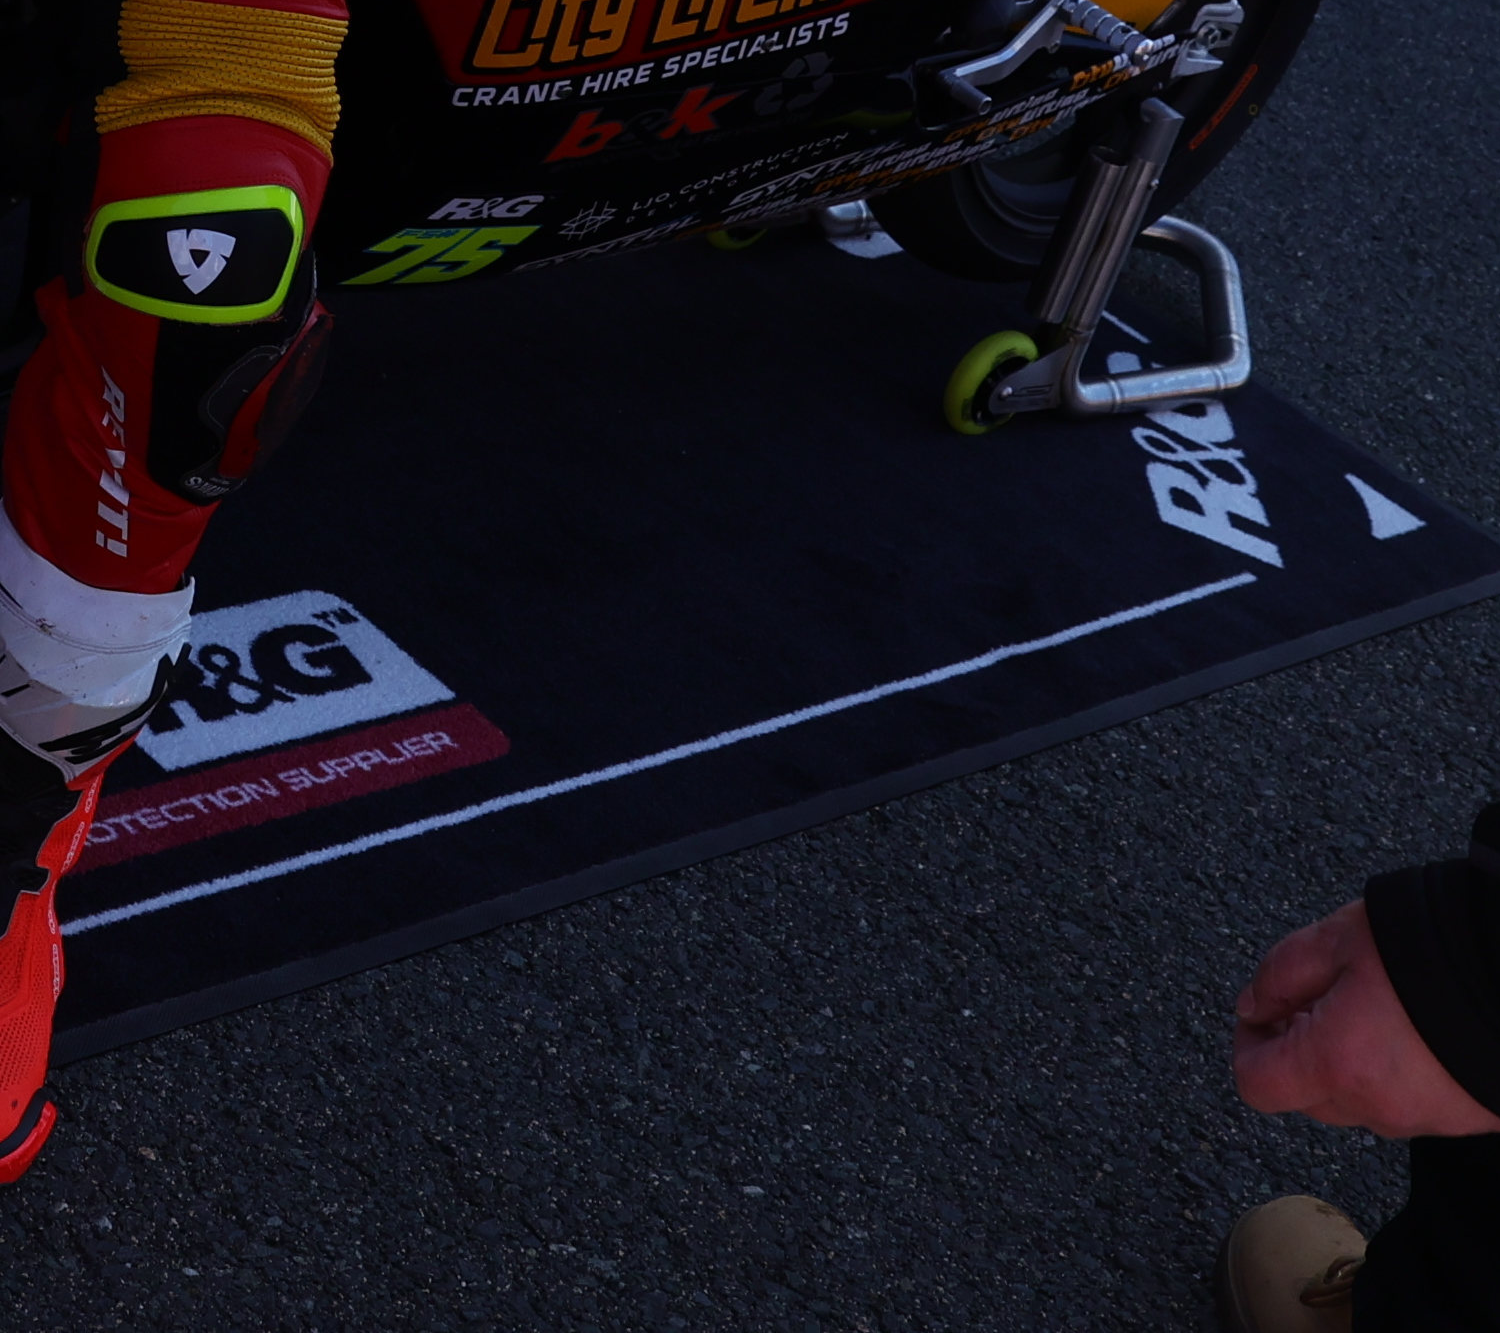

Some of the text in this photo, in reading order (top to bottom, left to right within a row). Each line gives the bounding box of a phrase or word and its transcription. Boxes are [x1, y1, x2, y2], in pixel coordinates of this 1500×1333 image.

[451, 11, 853, 107] CRANE HIRE SPECIALISTS
[677, 131, 850, 196] CONSTRUCTION
[427, 195, 545, 221] R&G
[336, 225, 543, 285] 75
[84, 730, 461, 845] OTECTION SUPPLIER
